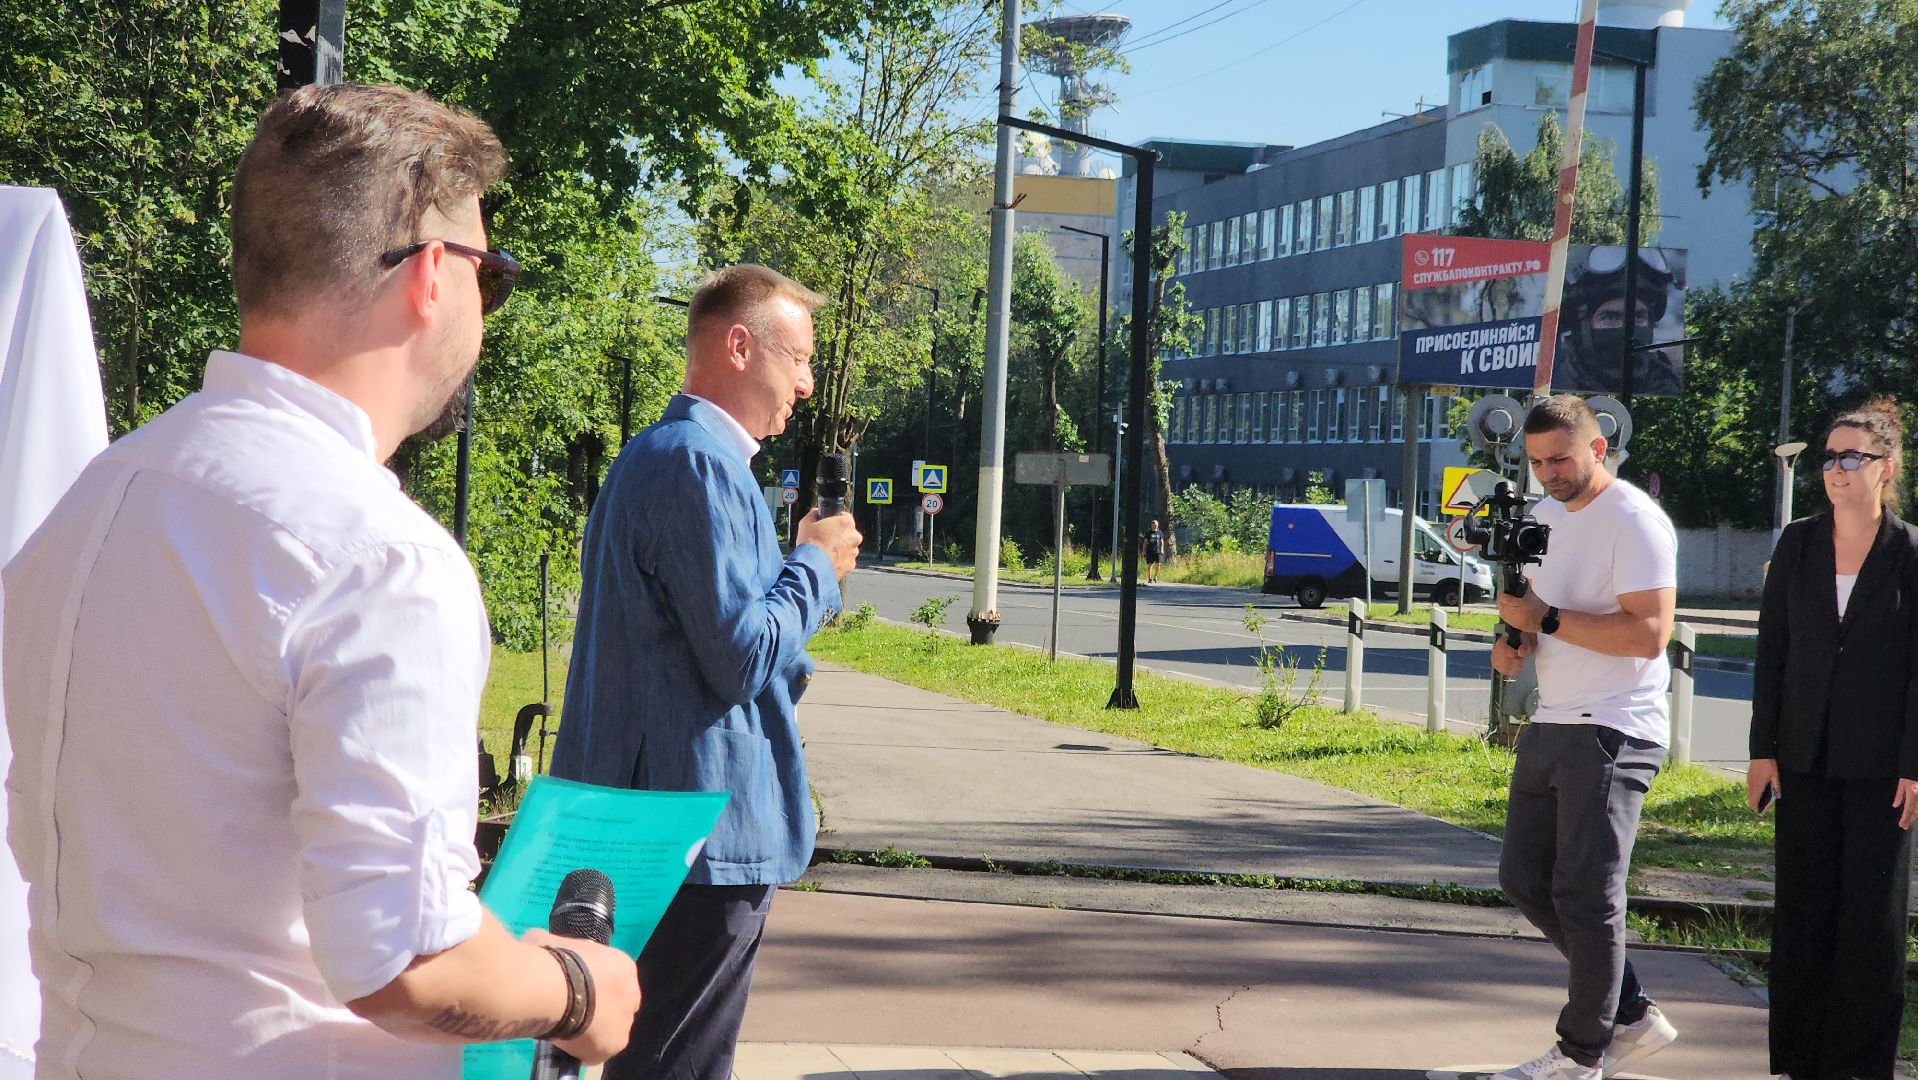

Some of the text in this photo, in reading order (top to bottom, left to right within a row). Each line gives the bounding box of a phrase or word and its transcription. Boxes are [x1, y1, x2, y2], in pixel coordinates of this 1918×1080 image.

[1431, 247, 1455, 267] 117
[1413, 260, 1541, 284] СЛУЖБАПОКОНТРАКТУ.РФ
[1415, 322, 1536, 354] ПРИСОЕДИНЯЙСЯ
[1460, 349, 1475, 375] К
[784, 492, 795, 500] 20
[926, 499, 938, 508] 20
